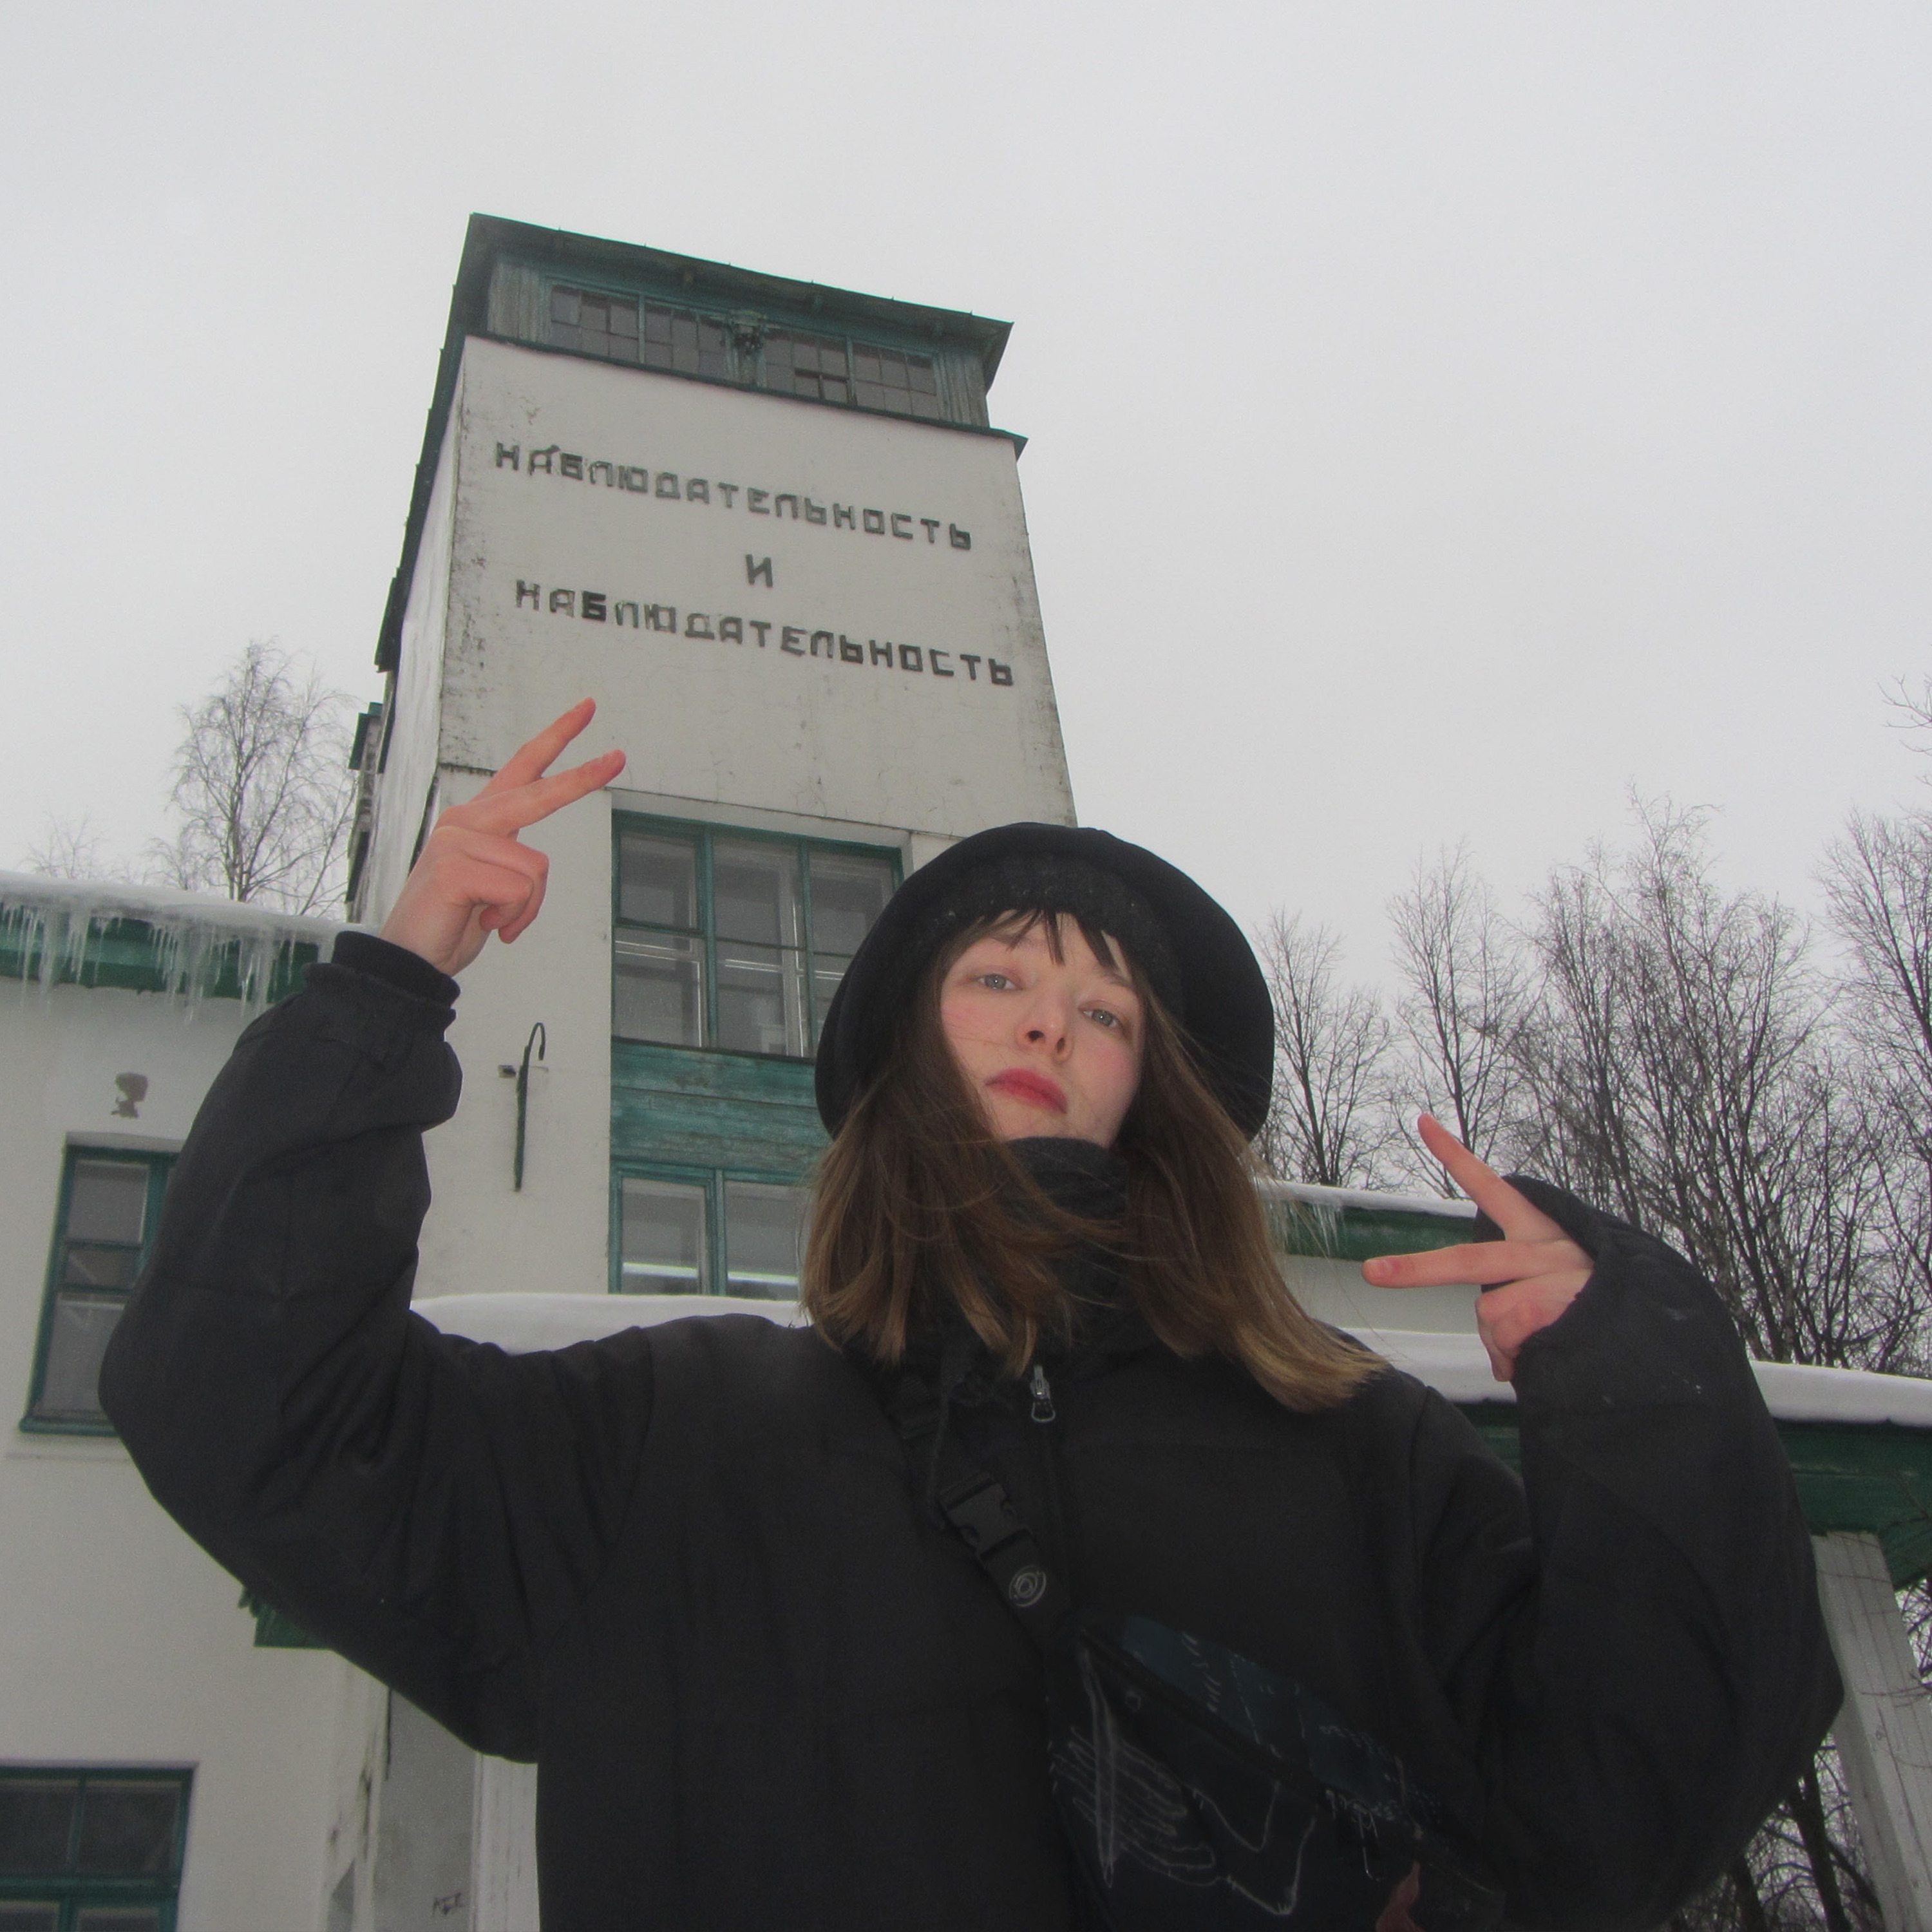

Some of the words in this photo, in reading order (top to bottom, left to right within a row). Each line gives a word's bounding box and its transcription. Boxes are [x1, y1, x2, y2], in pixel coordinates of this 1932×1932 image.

[495, 442, 971, 550] НАБЛЮДАТЕЛЬНОСТЬ
[745, 554, 773, 587] И
[516, 580, 1013, 686] НАБЛЮДАТЕЛЬНОСТЬ
